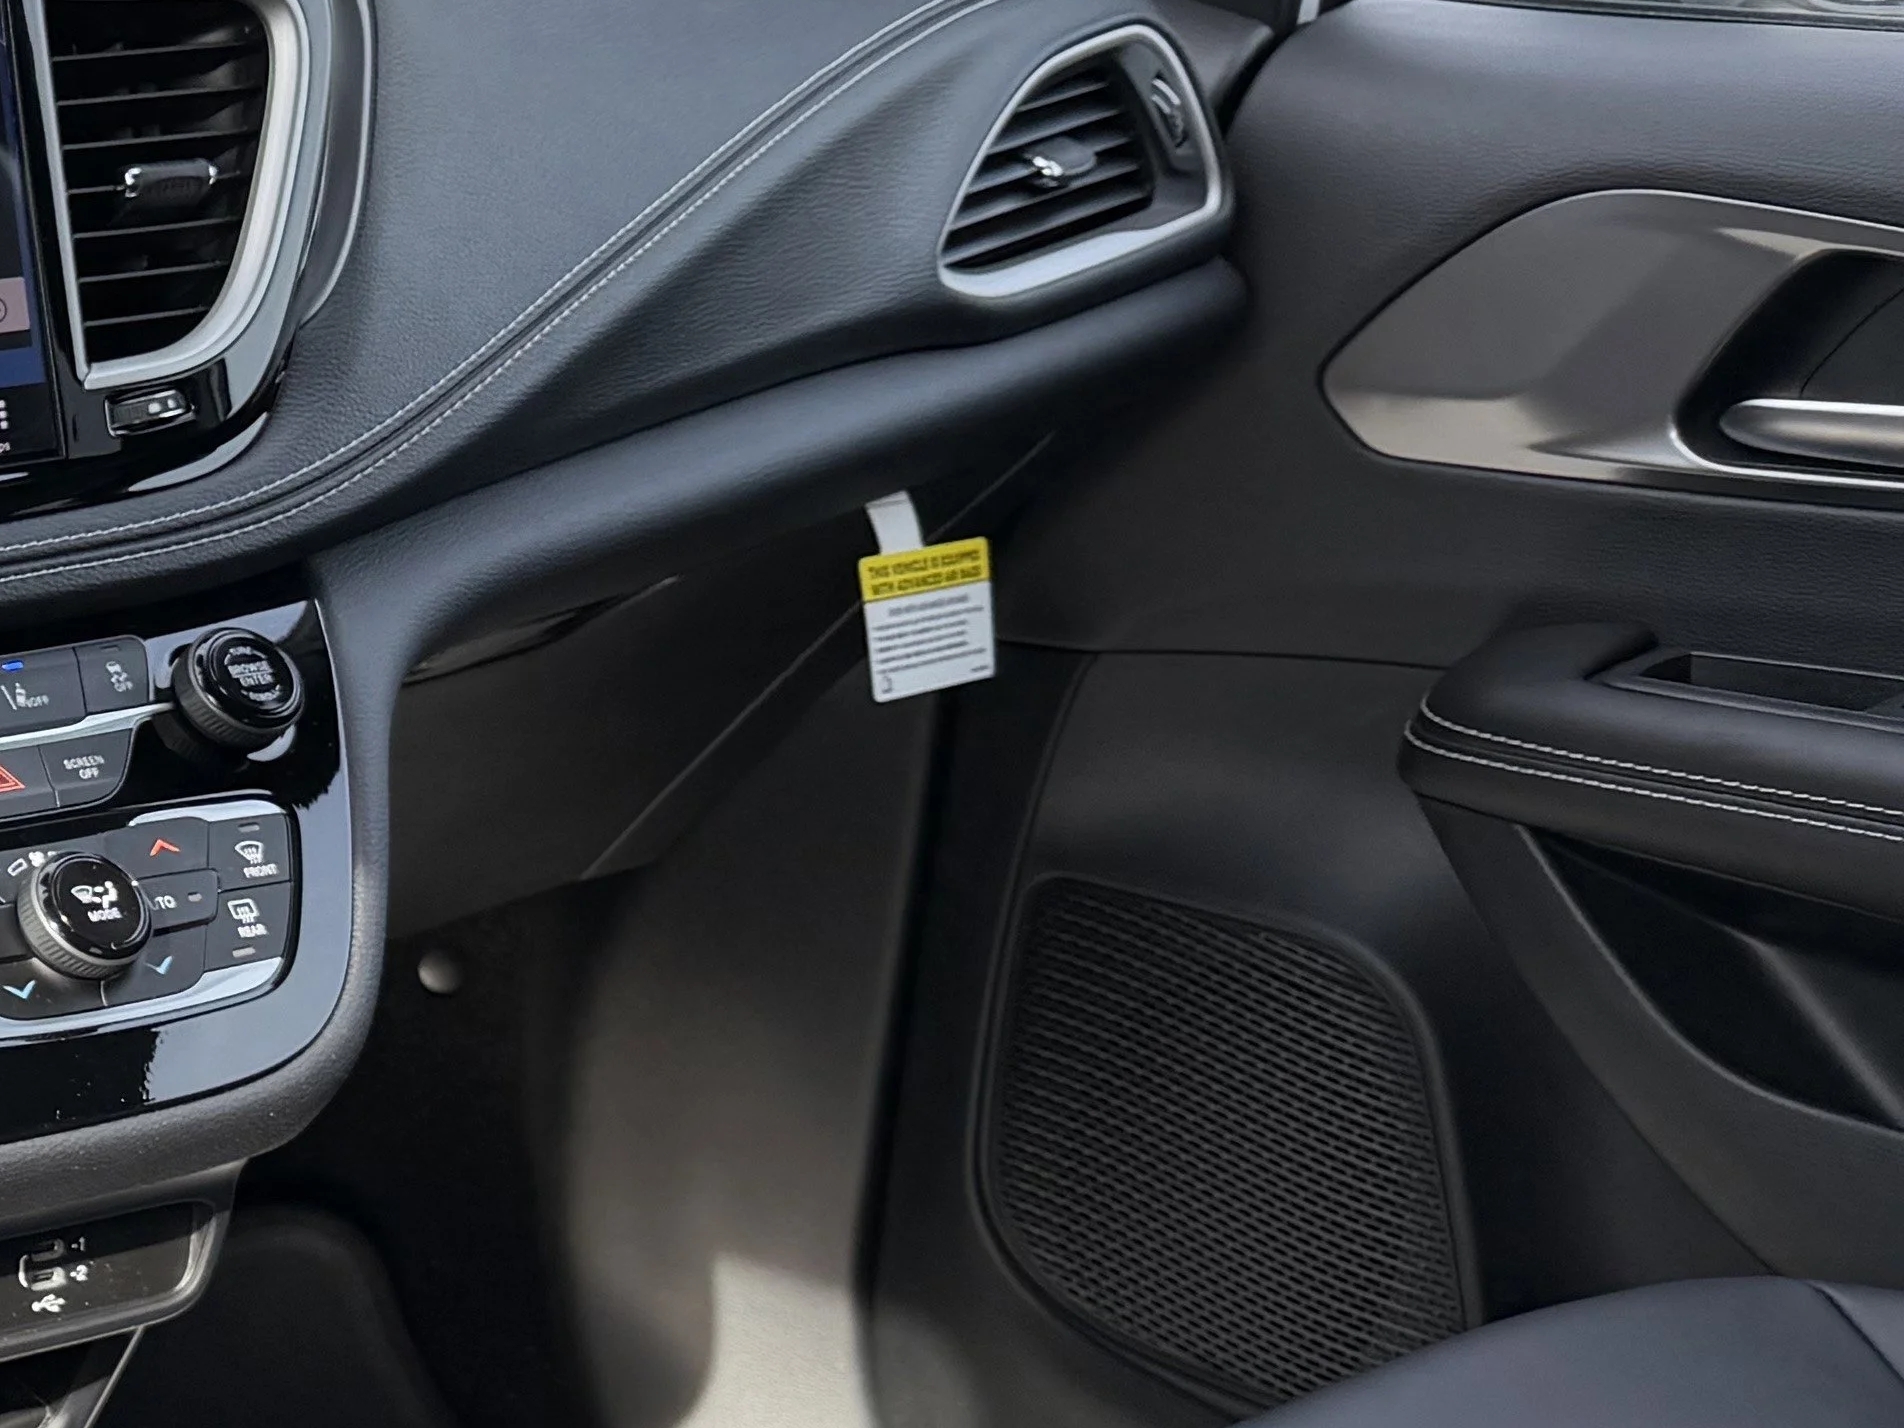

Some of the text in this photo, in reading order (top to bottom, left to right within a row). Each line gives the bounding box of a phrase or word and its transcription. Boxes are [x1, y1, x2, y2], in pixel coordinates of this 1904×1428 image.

[63, 754, 104, 770] SCREEN
[79, 767, 99, 780] OFF
[243, 863, 279, 879] FRONT
[87, 907, 123, 922] MODE
[237, 923, 268, 938] REAR
